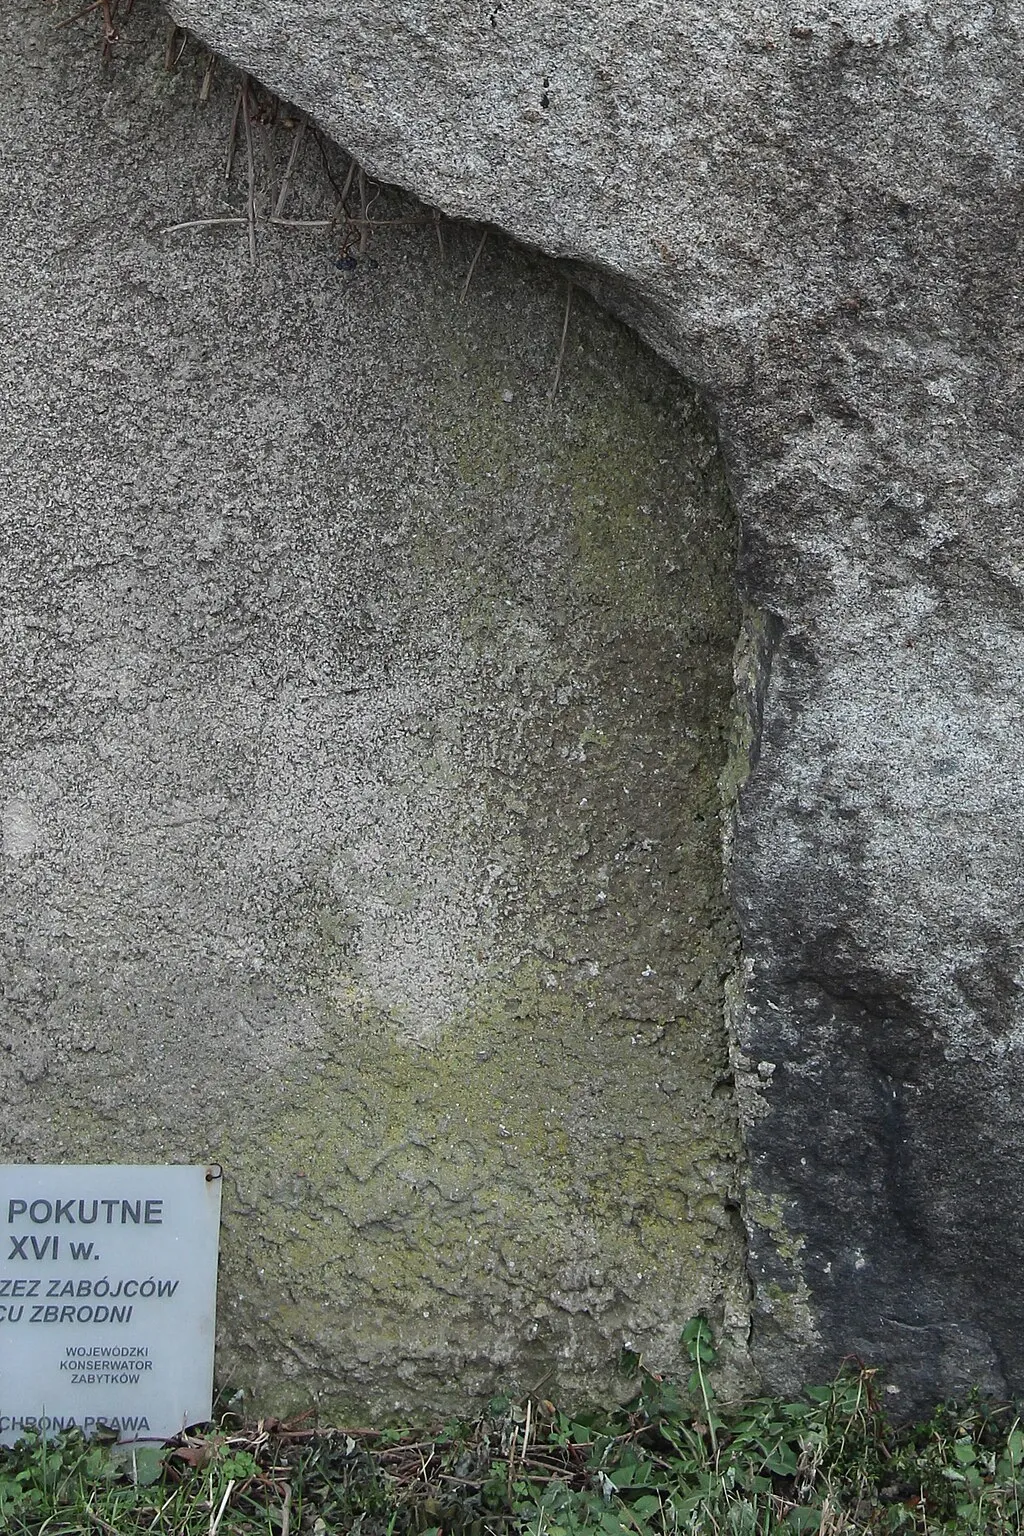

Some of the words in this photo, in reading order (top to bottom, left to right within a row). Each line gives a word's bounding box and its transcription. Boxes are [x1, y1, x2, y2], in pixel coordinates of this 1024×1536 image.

[8, 1199, 163, 1224] POKUTNE
[8, 1236, 59, 1260] XVI
[70, 1242, 100, 1260] w.
[46, 1276, 179, 1298] ZABÓJCÓW
[29, 1305, 133, 1323] ZBRODNI
[66, 1345, 149, 1357] WOJEWÓDZKI
[60, 1360, 153, 1371] KONSERWATOR
[71, 1372, 140, 1384] ZABYTKÓW
